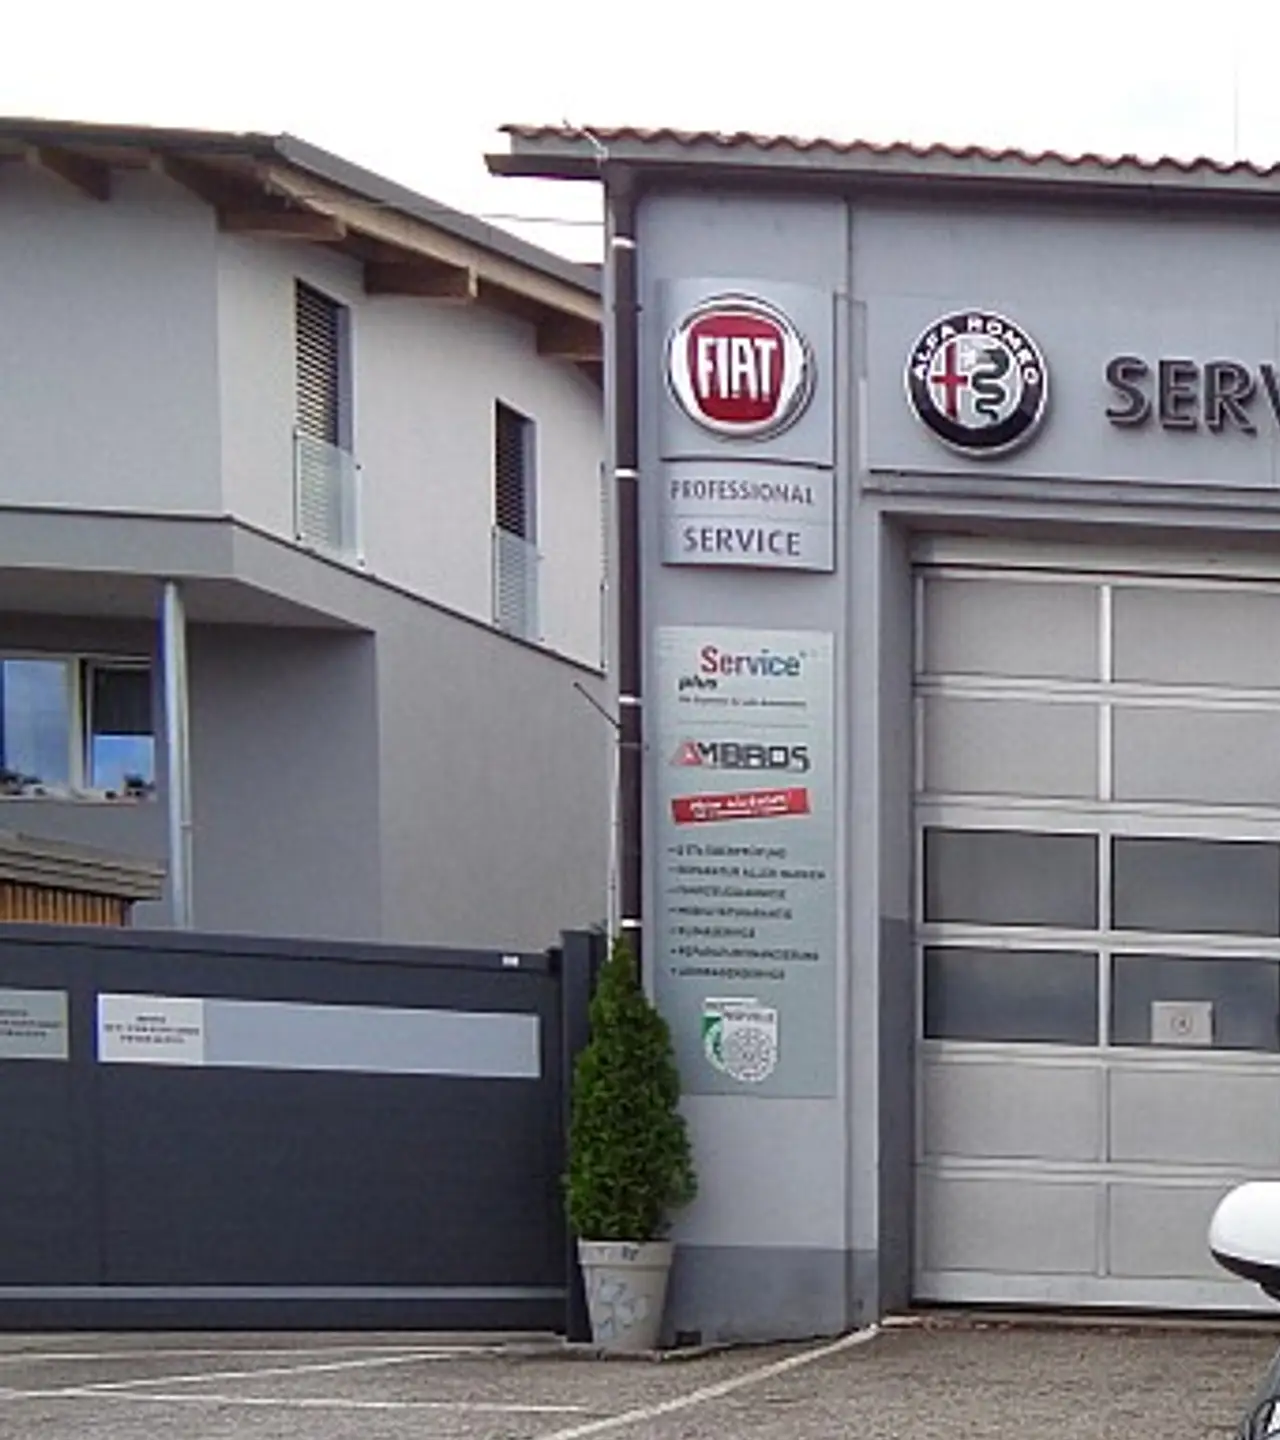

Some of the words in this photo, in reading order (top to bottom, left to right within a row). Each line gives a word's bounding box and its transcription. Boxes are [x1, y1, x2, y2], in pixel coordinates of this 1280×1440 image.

[913, 325, 956, 380] ALFA
[967, 316, 1039, 384] ROMEO
[696, 336, 778, 399] FIAT
[670, 480, 814, 505] PROFESSIONAL
[683, 528, 801, 556] SERVICE
[701, 645, 800, 676] Service
[670, 737, 810, 774] AMBROS
